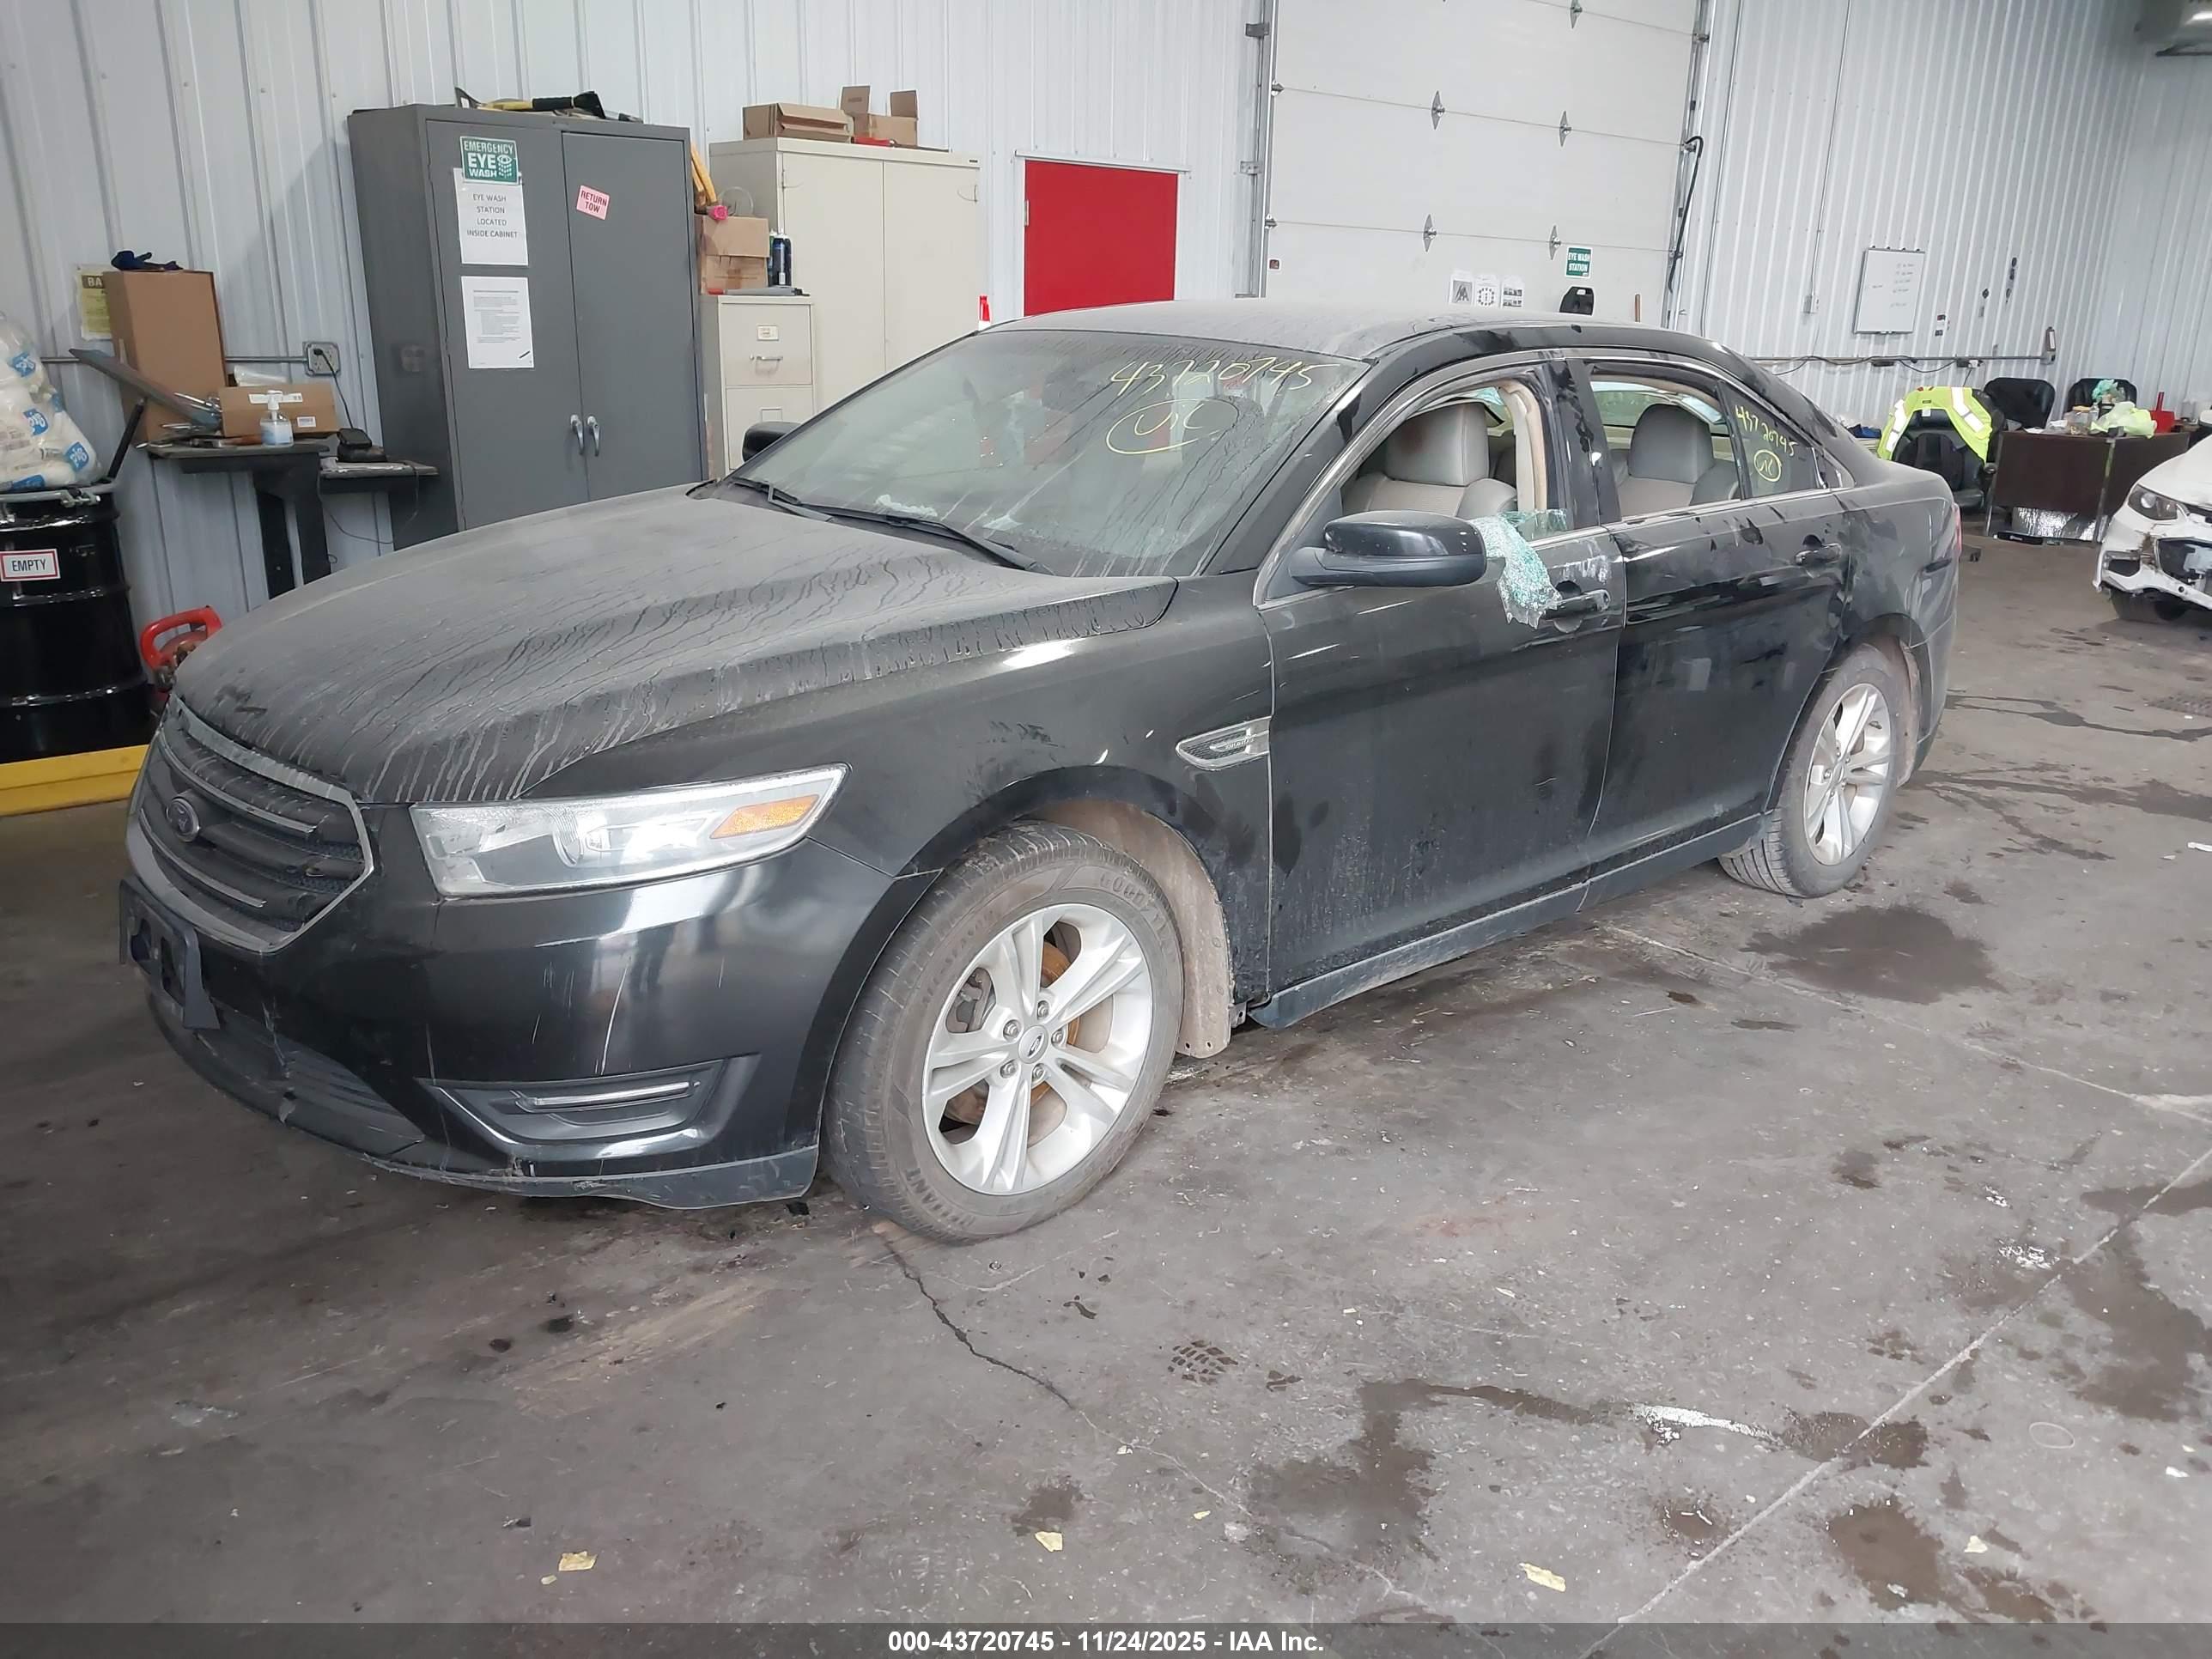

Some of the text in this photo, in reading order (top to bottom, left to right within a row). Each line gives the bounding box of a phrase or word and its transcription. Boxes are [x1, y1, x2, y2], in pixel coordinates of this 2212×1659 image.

[464, 140, 514, 154] EMERGENCY
[467, 152, 497, 169] EYE
[469, 168, 497, 178] WASH
[580, 190, 607, 207] RETURN
[585, 201, 601, 213] TOW
[466, 229, 489, 238] INSIDE
[1568, 252, 1577, 261] EYE
[1568, 263, 1589, 272] STATION
[87, 276, 104, 287] BA
[1110, 356, 1340, 396] 43720745
[11, 558, 46, 572] EMPTY
